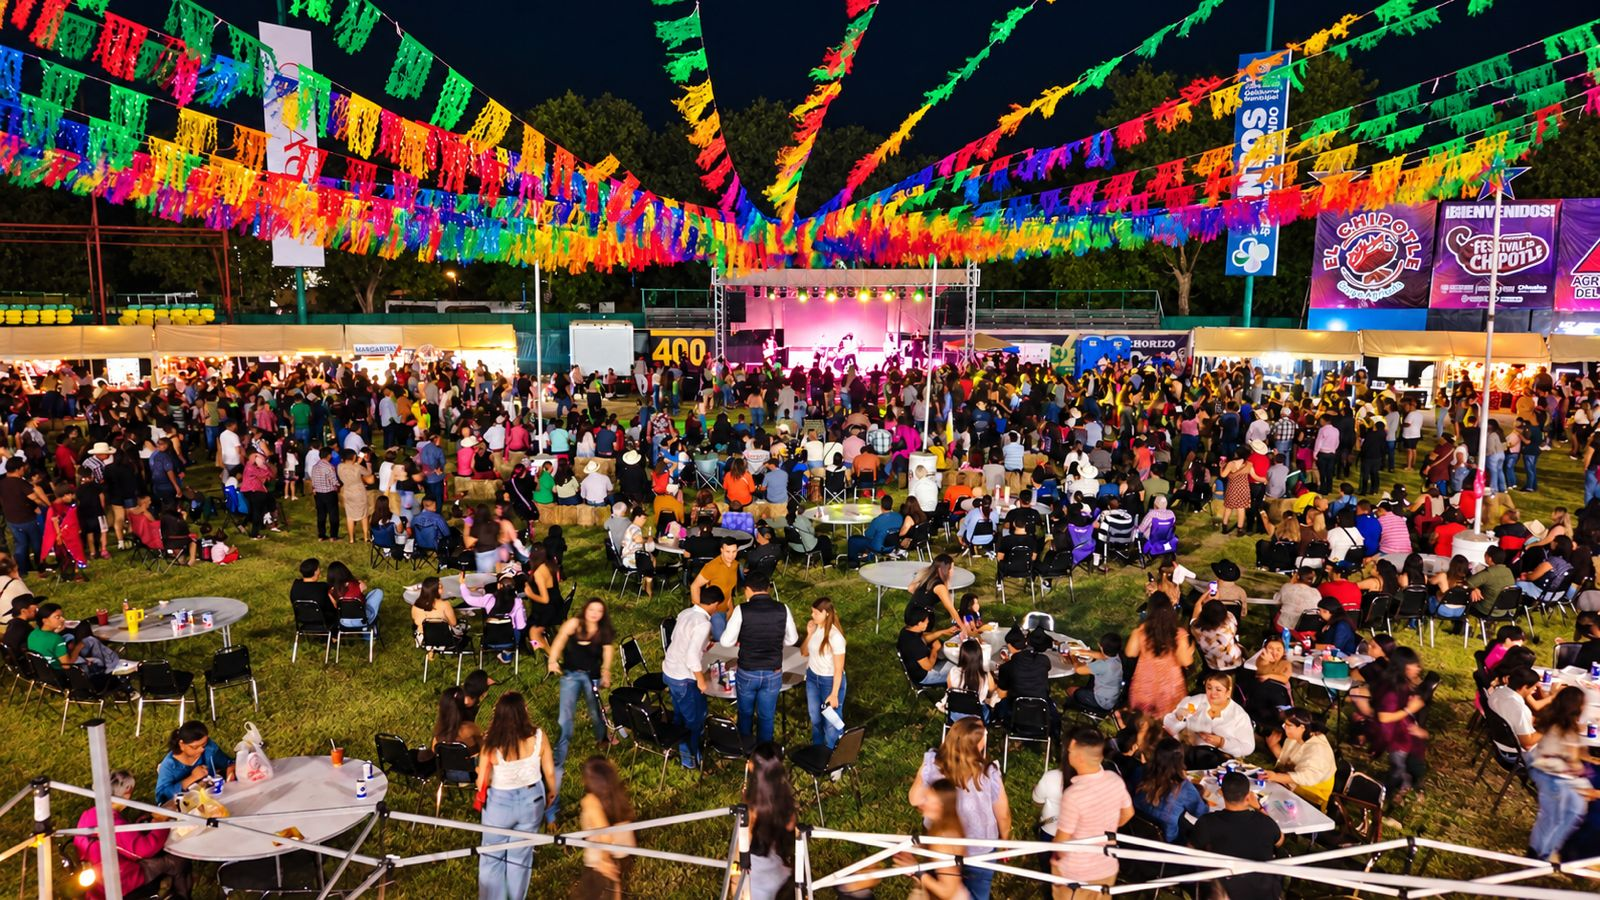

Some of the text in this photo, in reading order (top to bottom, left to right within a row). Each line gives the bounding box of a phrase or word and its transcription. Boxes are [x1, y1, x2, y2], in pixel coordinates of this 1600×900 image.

[1323, 212, 1422, 271] EL CHIPOTLE
[1473, 239, 1526, 255] FESIVAL
[1469, 245, 1543, 270] CHPOTLE
[1575, 288, 1599, 298] DEL
[652, 337, 707, 367] 400
